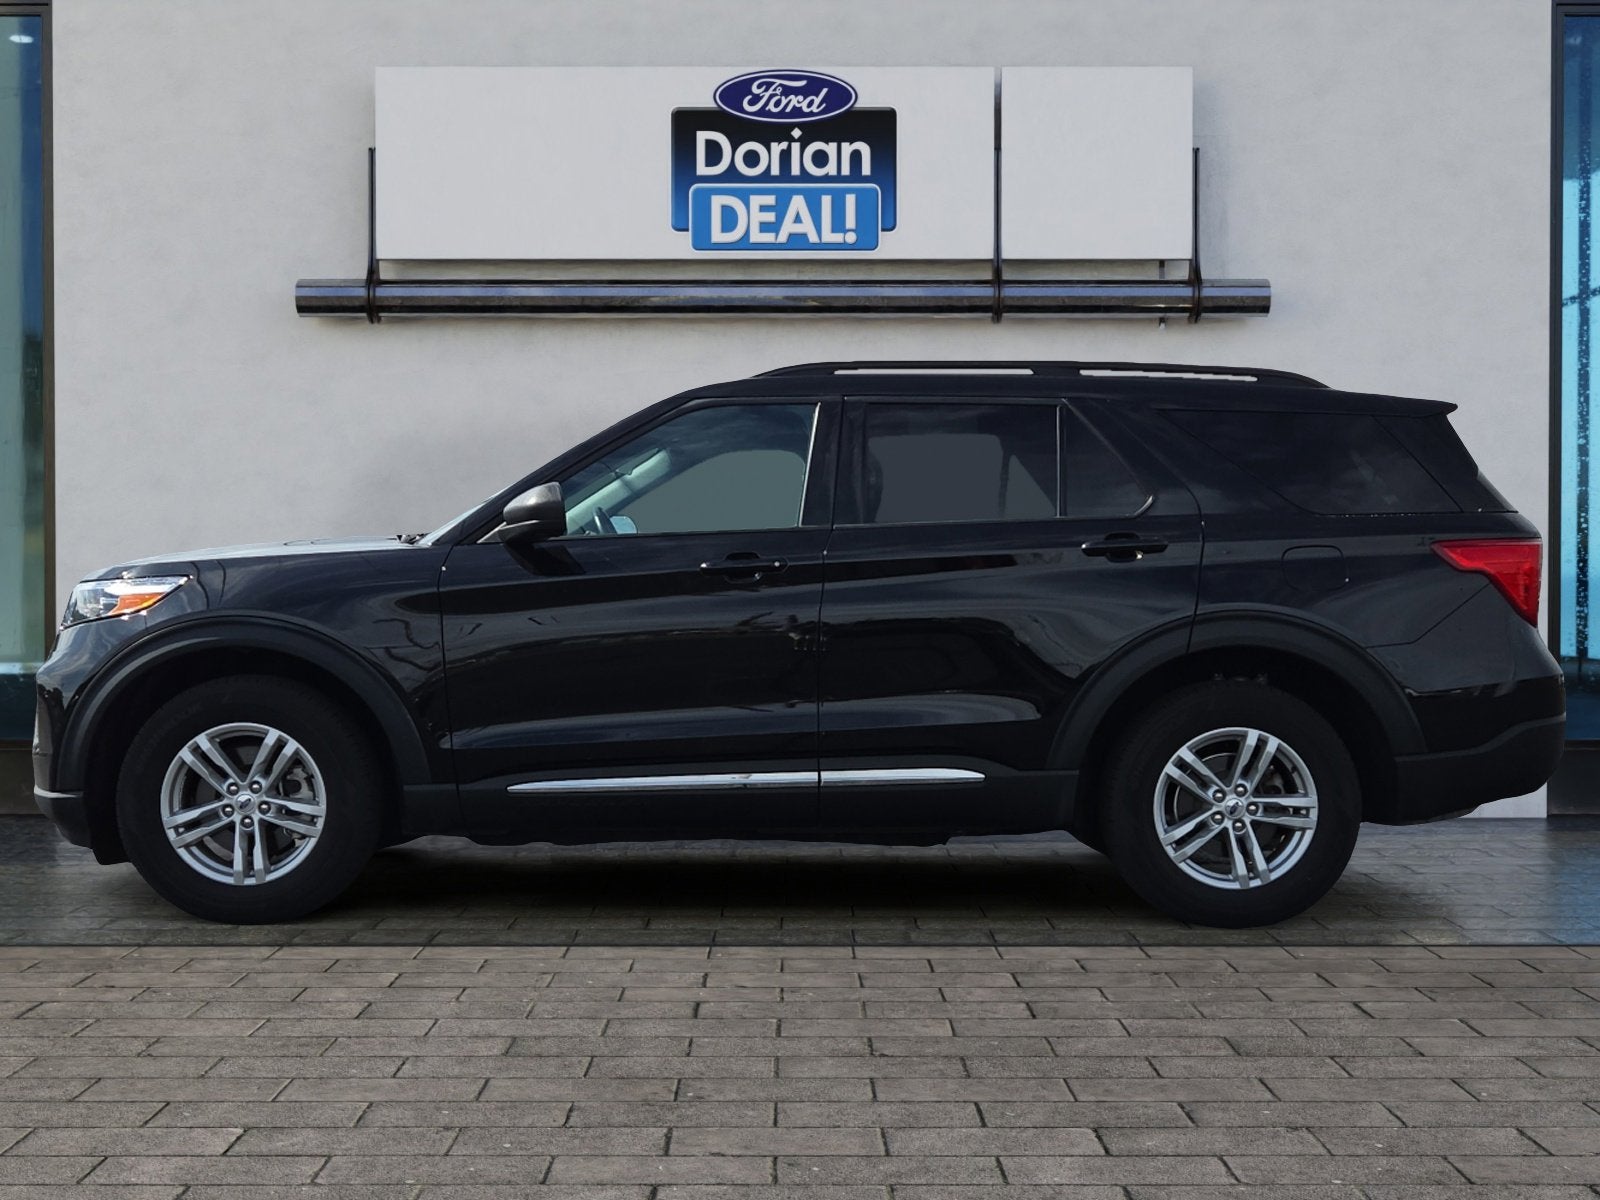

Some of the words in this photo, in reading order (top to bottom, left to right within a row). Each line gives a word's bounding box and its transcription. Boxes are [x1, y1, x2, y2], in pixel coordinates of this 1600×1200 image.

[742, 78, 829, 113] Ford
[695, 127, 872, 176] Dorian
[710, 193, 857, 244] DEAL!
